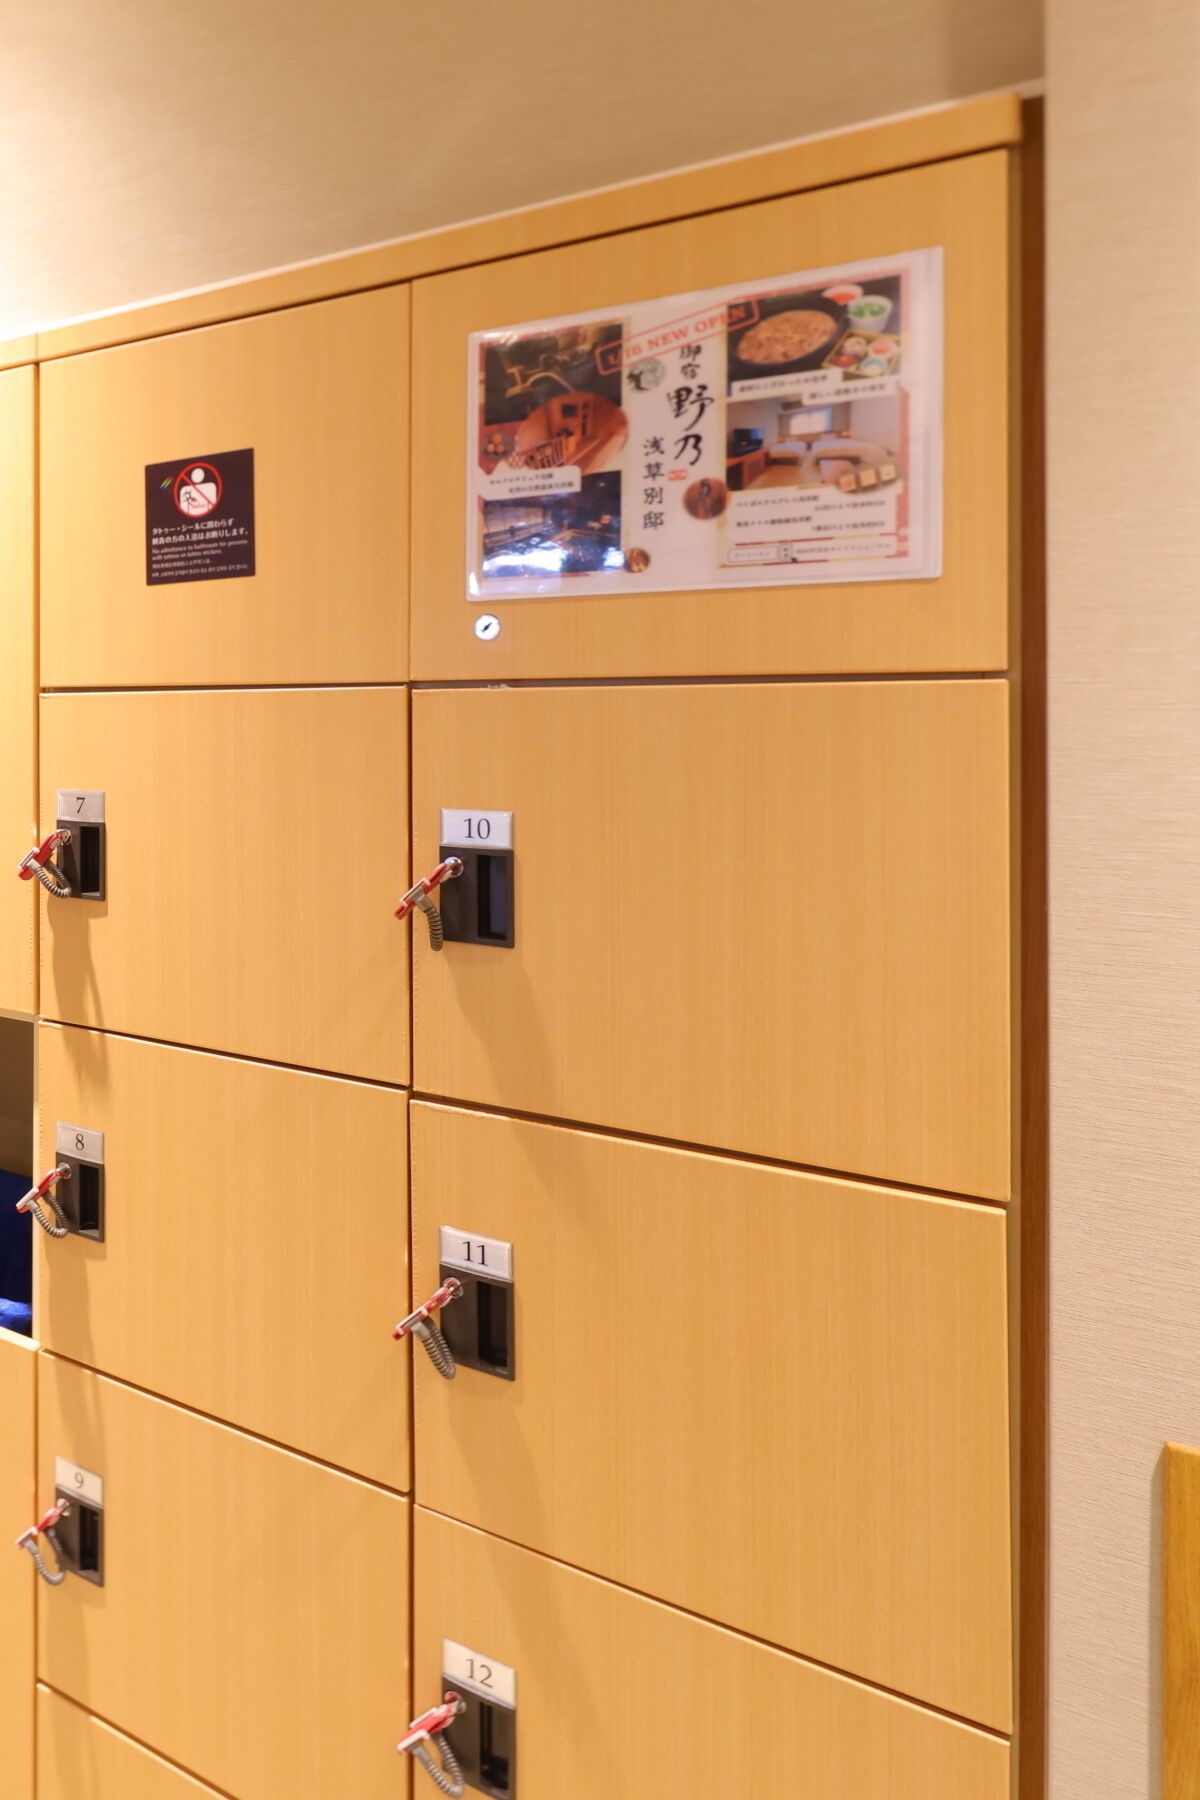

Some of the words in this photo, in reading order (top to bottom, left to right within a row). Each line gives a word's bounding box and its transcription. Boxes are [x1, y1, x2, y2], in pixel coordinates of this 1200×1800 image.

[648, 326, 689, 348] NEW
[694, 305, 746, 333] OPEN
[643, 435, 666, 531] 浅草別邸
[76, 796, 86, 814] 7
[463, 818, 491, 841] 10
[75, 1132, 86, 1152] 8
[461, 1241, 490, 1268] 11
[74, 1472, 85, 1491] 9
[465, 1658, 495, 1690] 12
